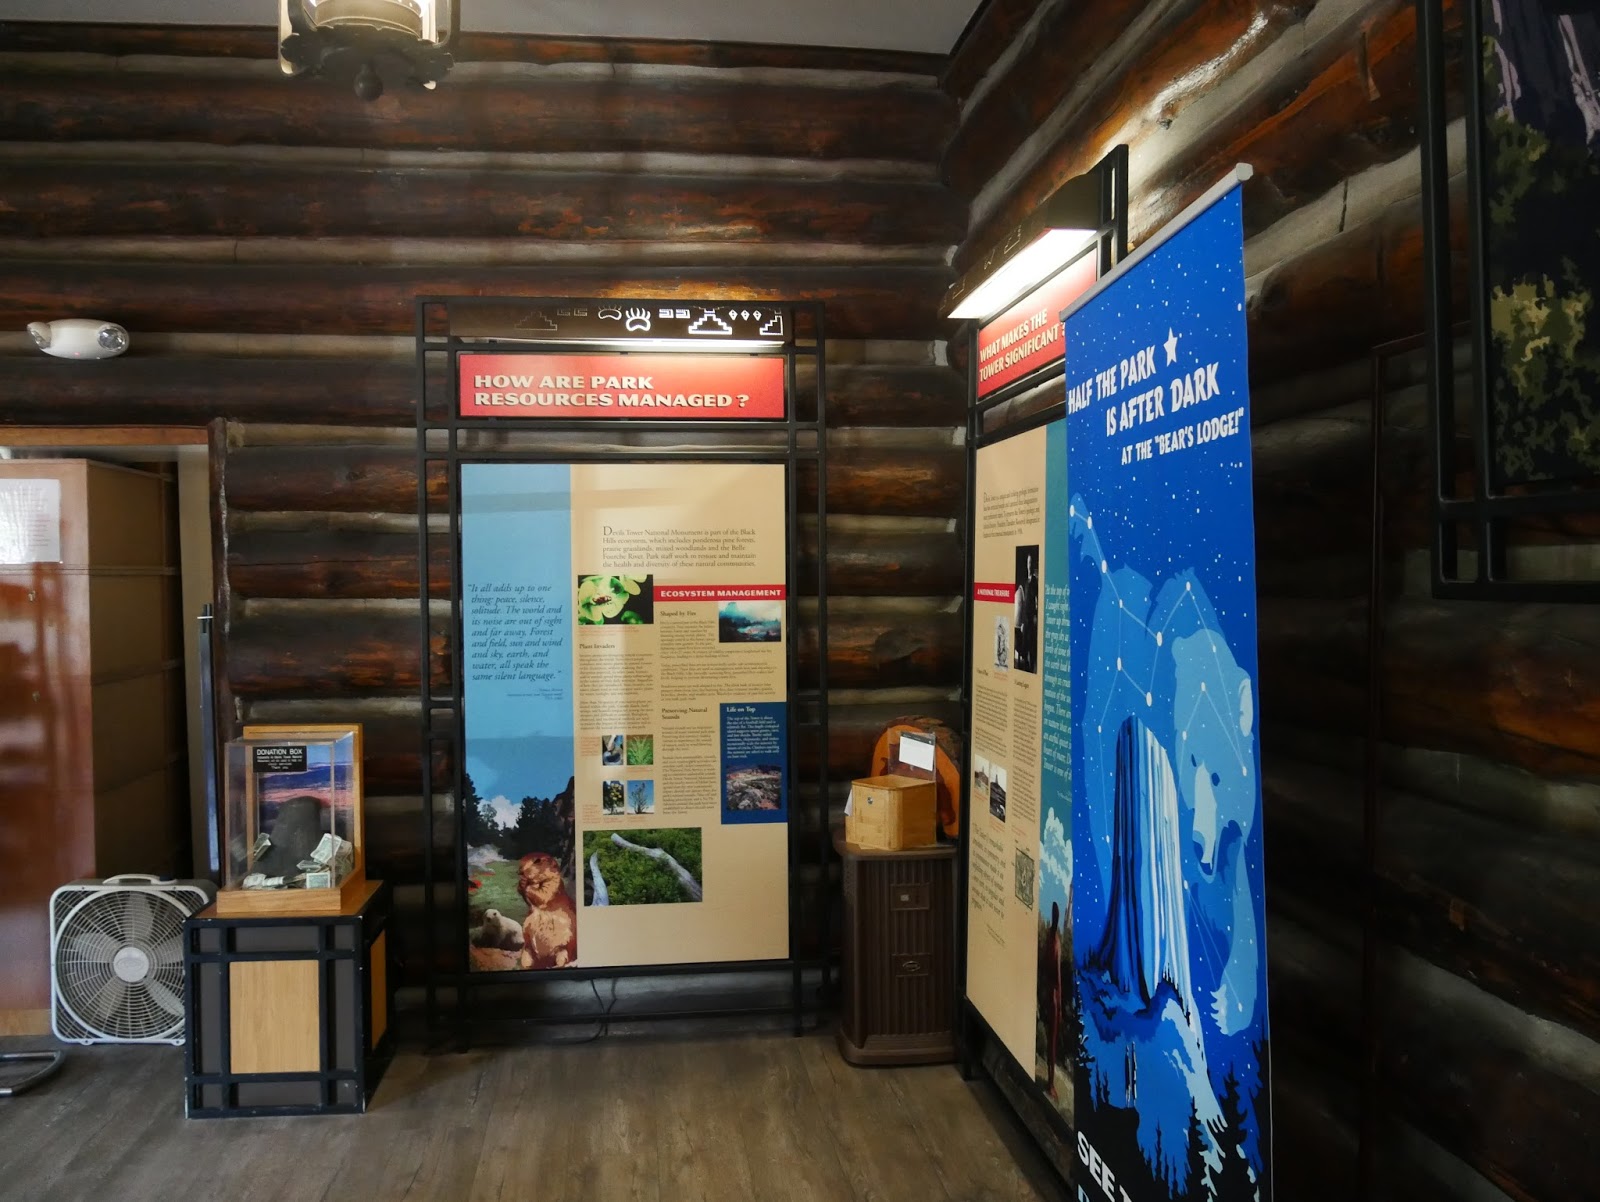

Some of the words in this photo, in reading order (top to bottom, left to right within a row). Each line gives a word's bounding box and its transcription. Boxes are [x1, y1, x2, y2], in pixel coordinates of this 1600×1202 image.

[980, 338, 1000, 362] WHAT
[1002, 320, 1029, 350] MAKES
[1030, 308, 1048, 332] THE
[979, 357, 1004, 382] TOWER
[1005, 324, 1059, 368] SIGNIFICANT
[474, 375, 534, 388] HOW
[539, 376, 585, 388] ARE
[591, 376, 654, 389] PARK
[1068, 378, 1092, 415] HALF
[1096, 364, 1118, 401] THE
[1120, 344, 1156, 390] PARK
[474, 392, 613, 406] RESOURCES
[618, 394, 732, 407] MANAGED
[1106, 406, 1117, 437] IS
[1120, 386, 1164, 431] AFTER
[1170, 362, 1220, 412] DARK
[1121, 445, 1133, 465] AT
[1136, 439, 1152, 462] THE
[480, 584, 491, 592] all
[522, 605, 544, 614] world
[546, 605, 563, 613] and
[534, 617, 543, 627] of
[544, 616, 562, 627] sight
[472, 628, 489, 636] and
[490, 628, 502, 637] far
[530, 628, 553, 636] Forest
[525, 638, 540, 646] and
[542, 638, 563, 646] wind
[490, 650, 503, 660] sky,
[533, 649, 550, 657] and
[500, 661, 510, 669] all
[512, 661, 534, 671] speak
[494, 672, 516, 680] silent
[1077, 1131, 1115, 1202] SEE
